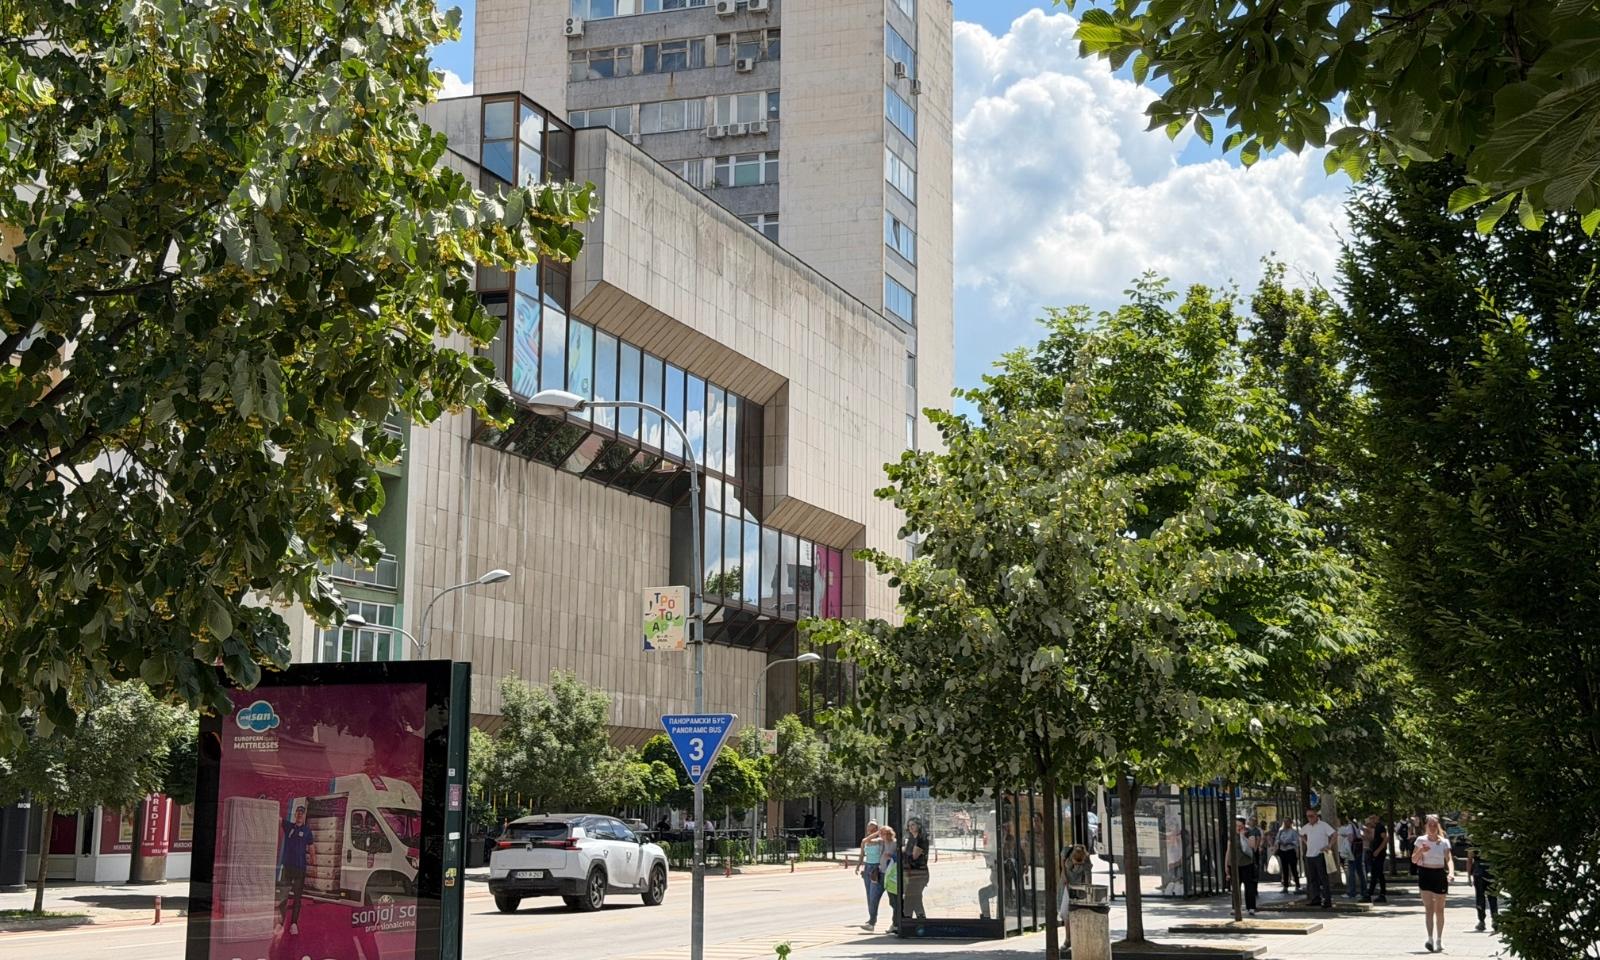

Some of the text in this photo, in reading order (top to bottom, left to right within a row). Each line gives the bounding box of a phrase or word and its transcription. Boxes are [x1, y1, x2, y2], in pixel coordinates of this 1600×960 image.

[668, 717, 712, 725] ПАНОРАМСКИ
[671, 726, 722, 734] PANORAMIC BUS
[688, 737, 704, 761] 3
[352, 904, 394, 927] sanjaj
[365, 919, 416, 933] profesionalcima
